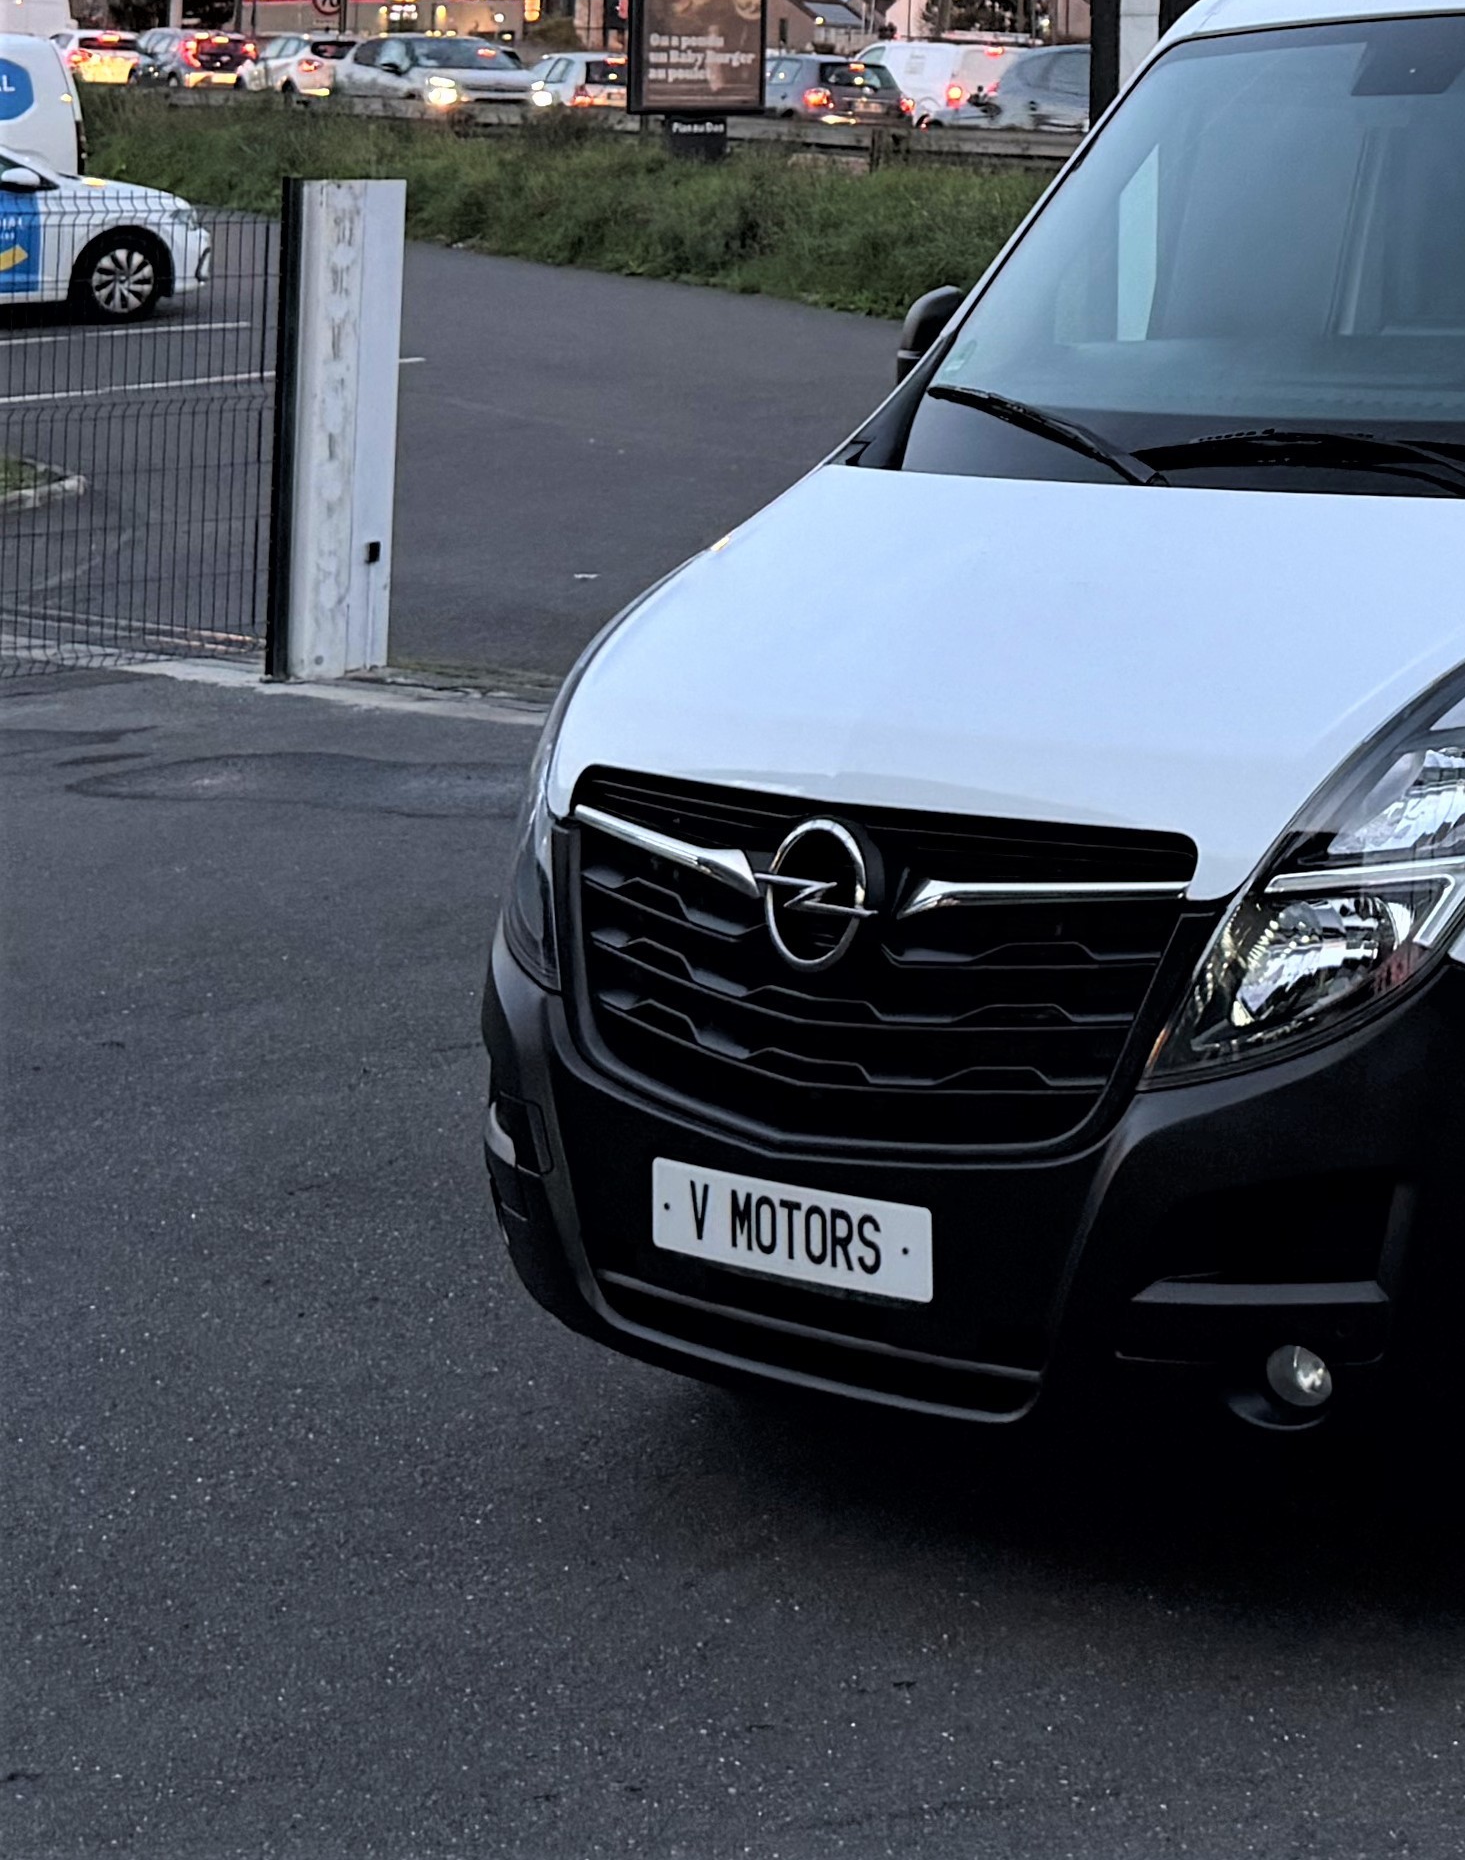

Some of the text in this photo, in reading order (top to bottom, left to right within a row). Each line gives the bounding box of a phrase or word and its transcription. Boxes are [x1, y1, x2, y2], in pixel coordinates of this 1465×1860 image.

[669, 49, 705, 70] Baby
[705, 49, 756, 68] Burger
[0, 75, 16, 92] L
[690, 1179, 881, 1275] V MOTORS
